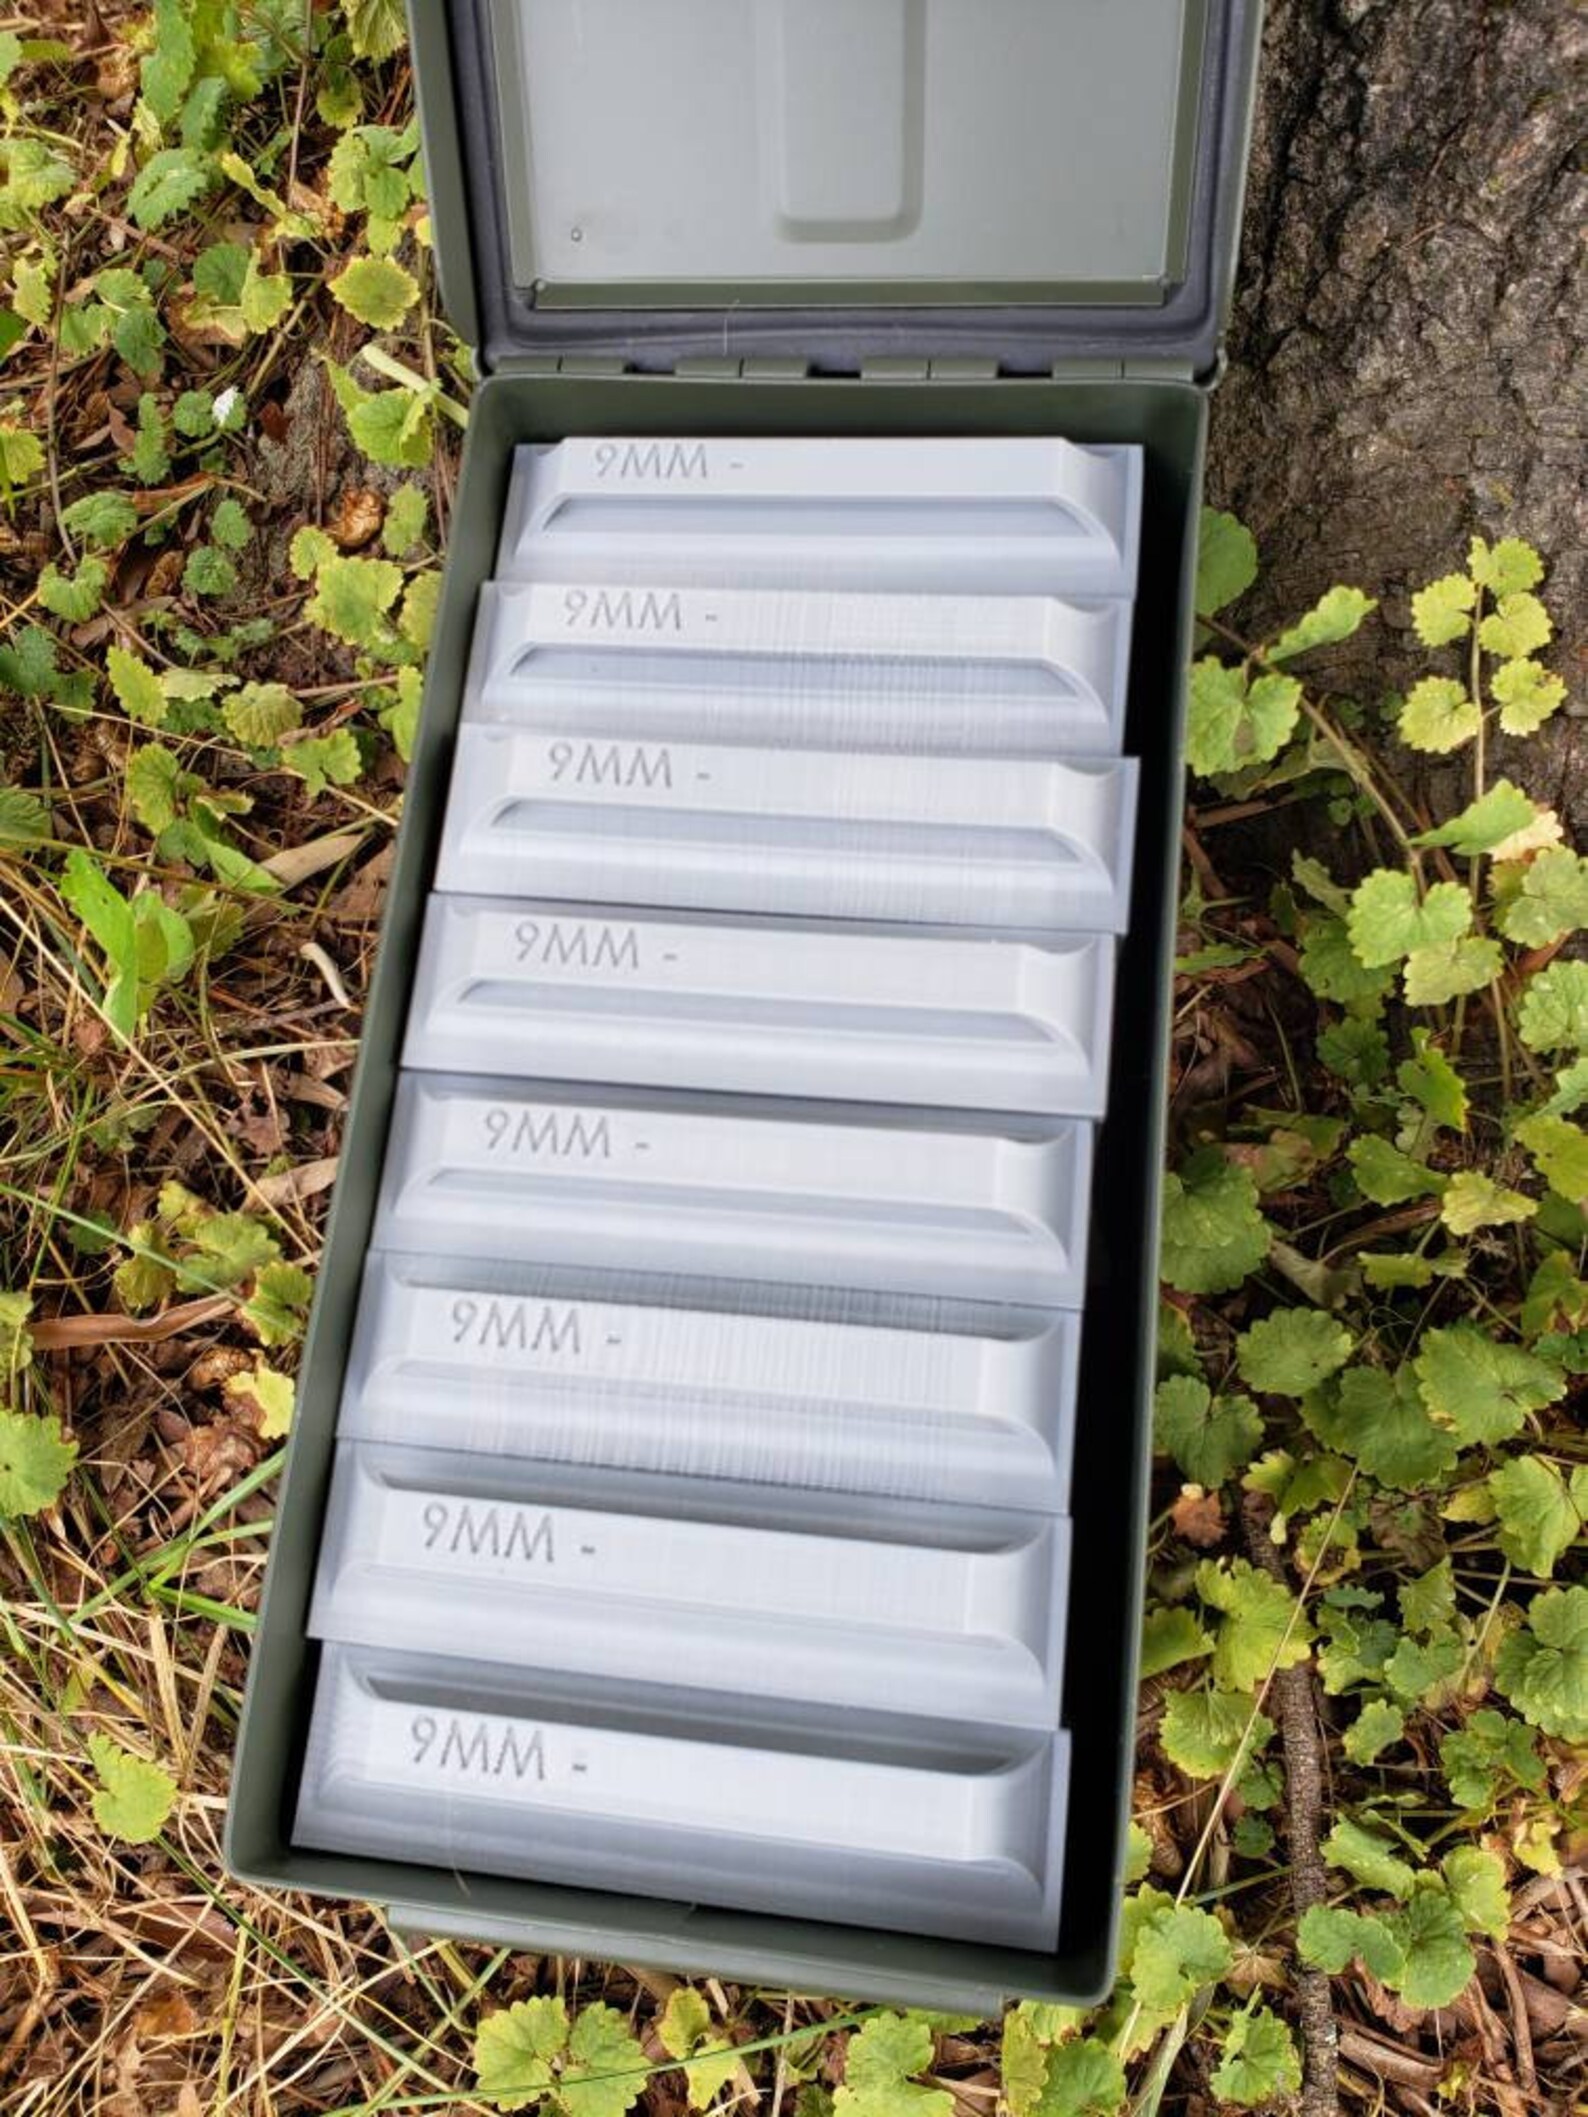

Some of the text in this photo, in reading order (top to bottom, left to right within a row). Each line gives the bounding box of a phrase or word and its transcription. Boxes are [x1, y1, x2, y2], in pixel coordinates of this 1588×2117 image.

[595, 443, 708, 478] 9MM
[564, 589, 681, 631] 9MM
[549, 742, 672, 788] 9MM
[515, 920, 639, 969] 9MM
[485, 1108, 610, 1158] 9MM
[452, 1300, 581, 1355] 9MM
[423, 1502, 555, 1563] 9MM
[411, 1714, 545, 1780] 9MM
